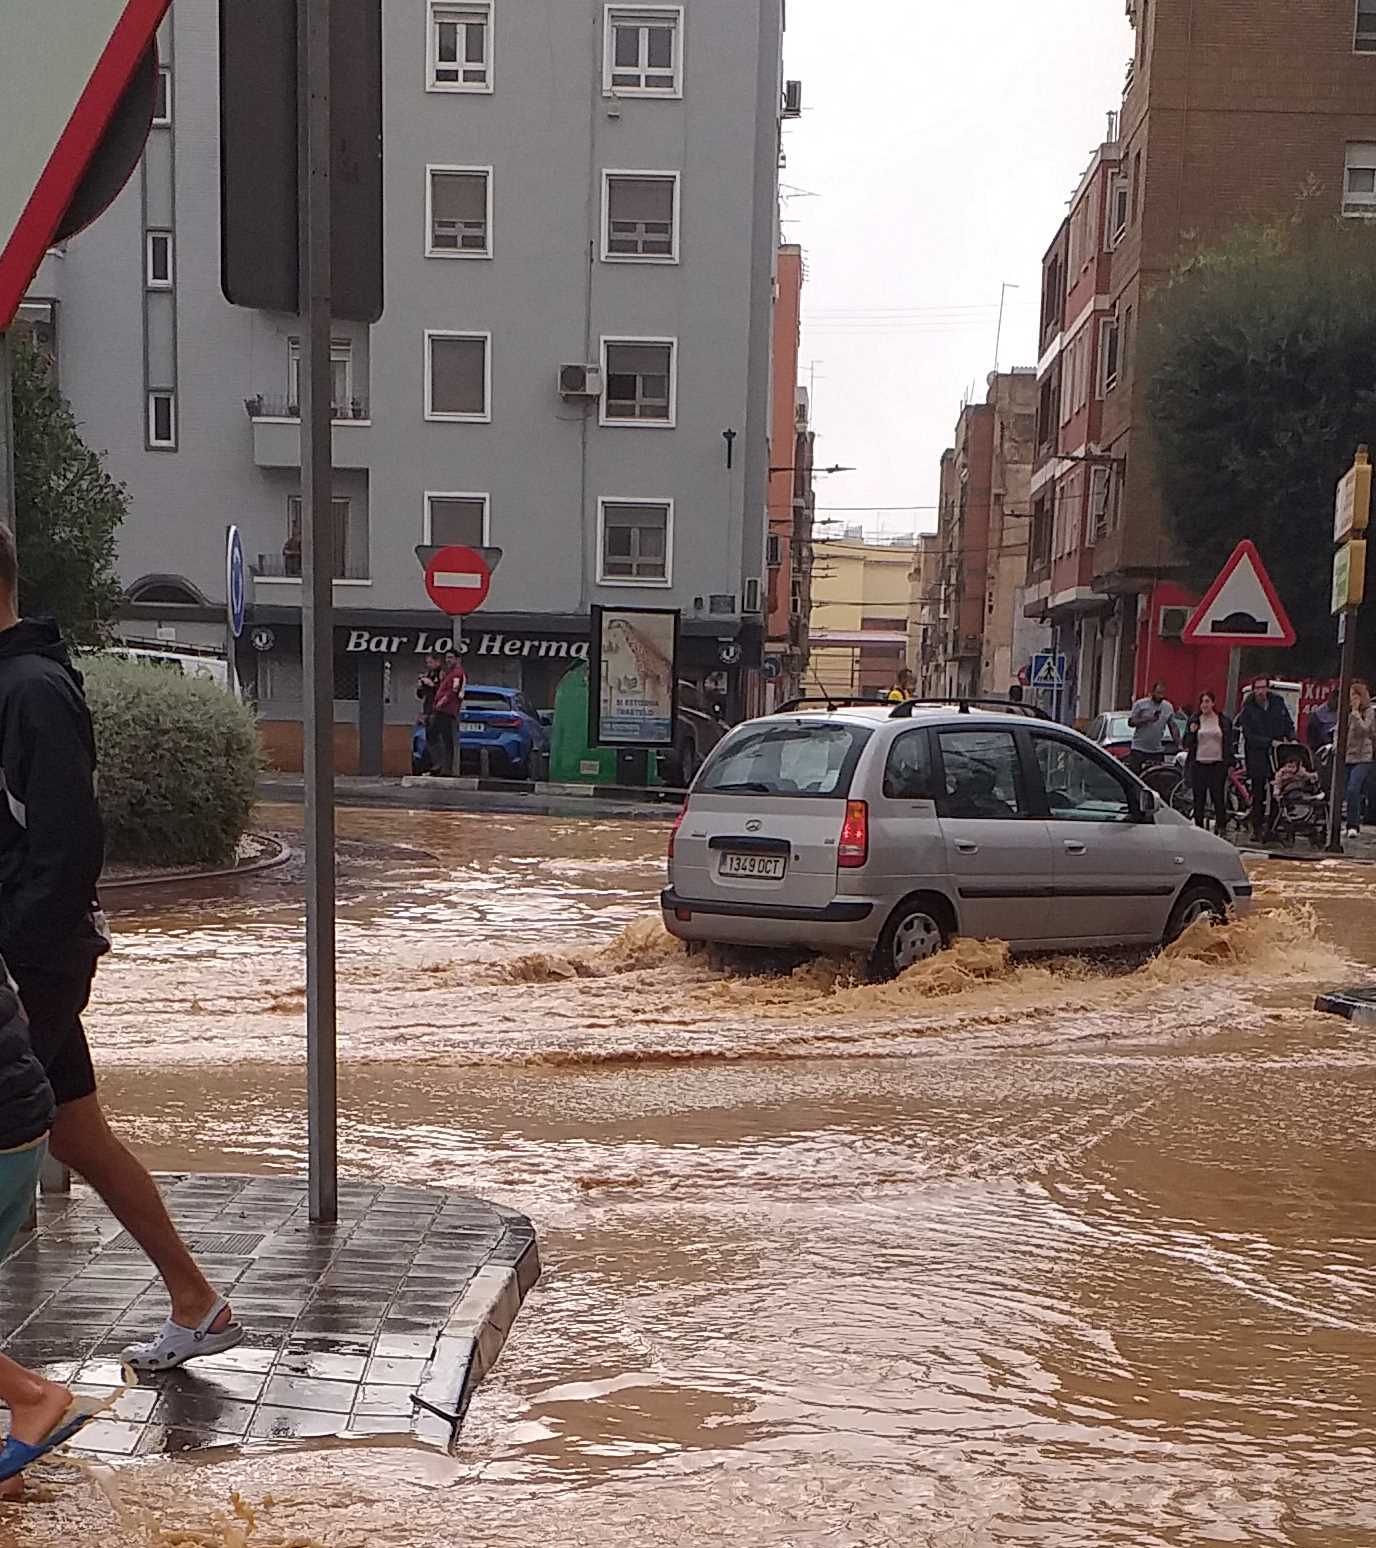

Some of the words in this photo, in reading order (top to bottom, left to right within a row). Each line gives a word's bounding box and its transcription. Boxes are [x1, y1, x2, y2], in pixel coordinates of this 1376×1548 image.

[346, 630, 408, 653] Bar
[414, 631, 471, 654] Los
[728, 856, 755, 873] 1349
